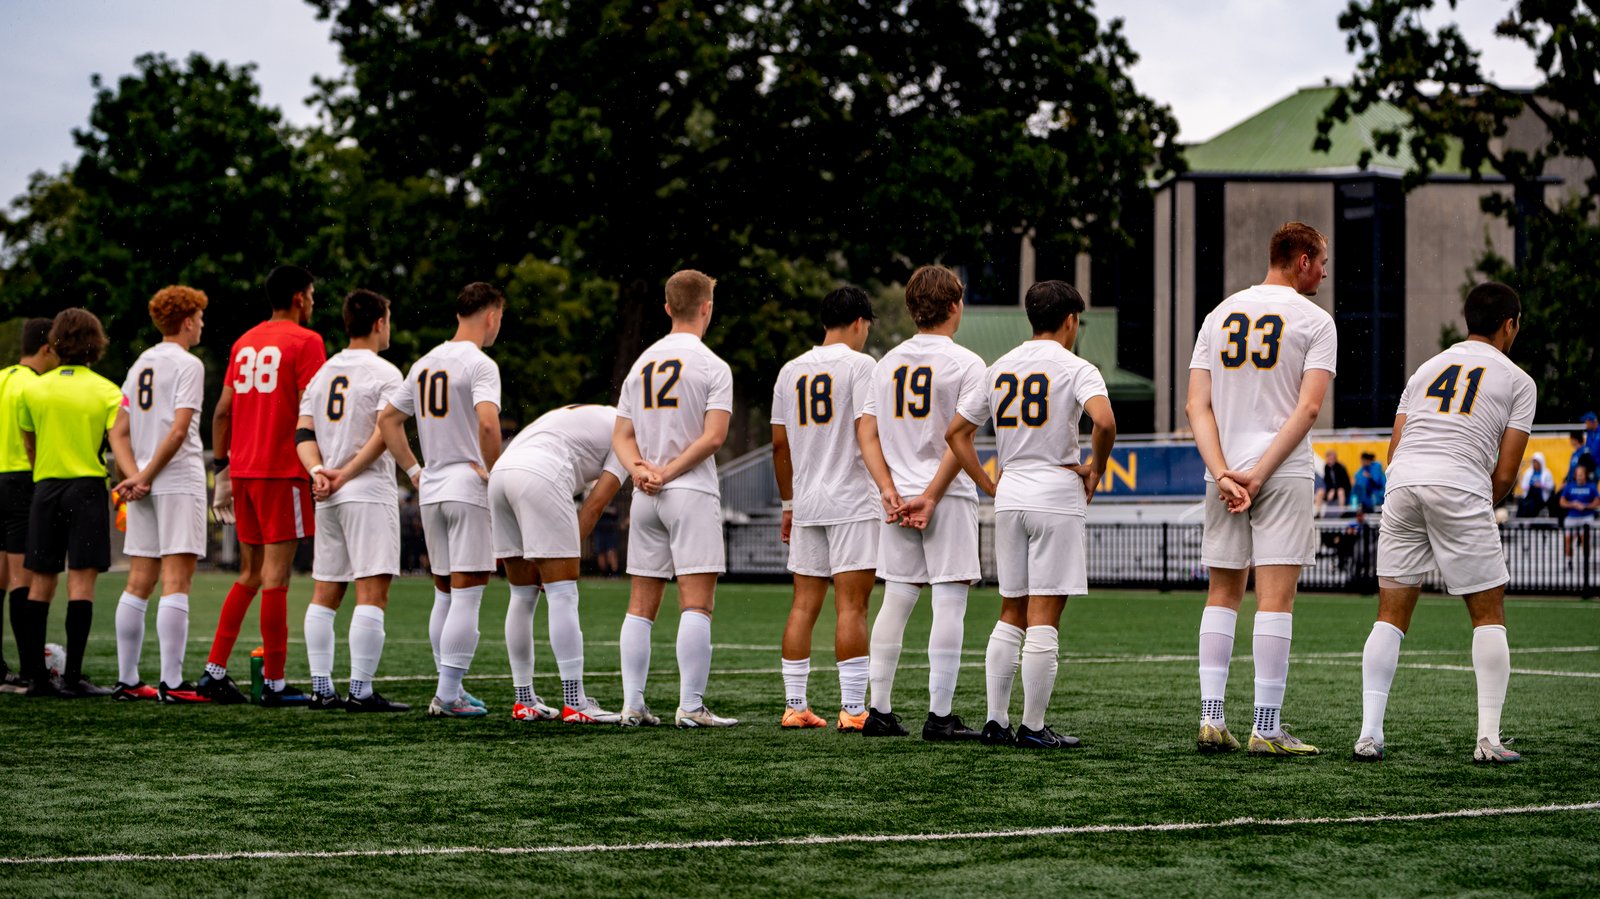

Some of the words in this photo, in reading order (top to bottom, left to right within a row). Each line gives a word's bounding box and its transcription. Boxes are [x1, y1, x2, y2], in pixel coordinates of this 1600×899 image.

[1220, 312, 1285, 371] 33
[138, 367, 154, 411] 8
[233, 345, 282, 394] 38
[417, 368, 449, 419] 10
[640, 358, 684, 410] 12
[892, 364, 933, 420] 19
[1425, 364, 1487, 416] 41
[326, 375, 349, 422] 6
[796, 371, 834, 427] 18
[994, 371, 1051, 429] 28
